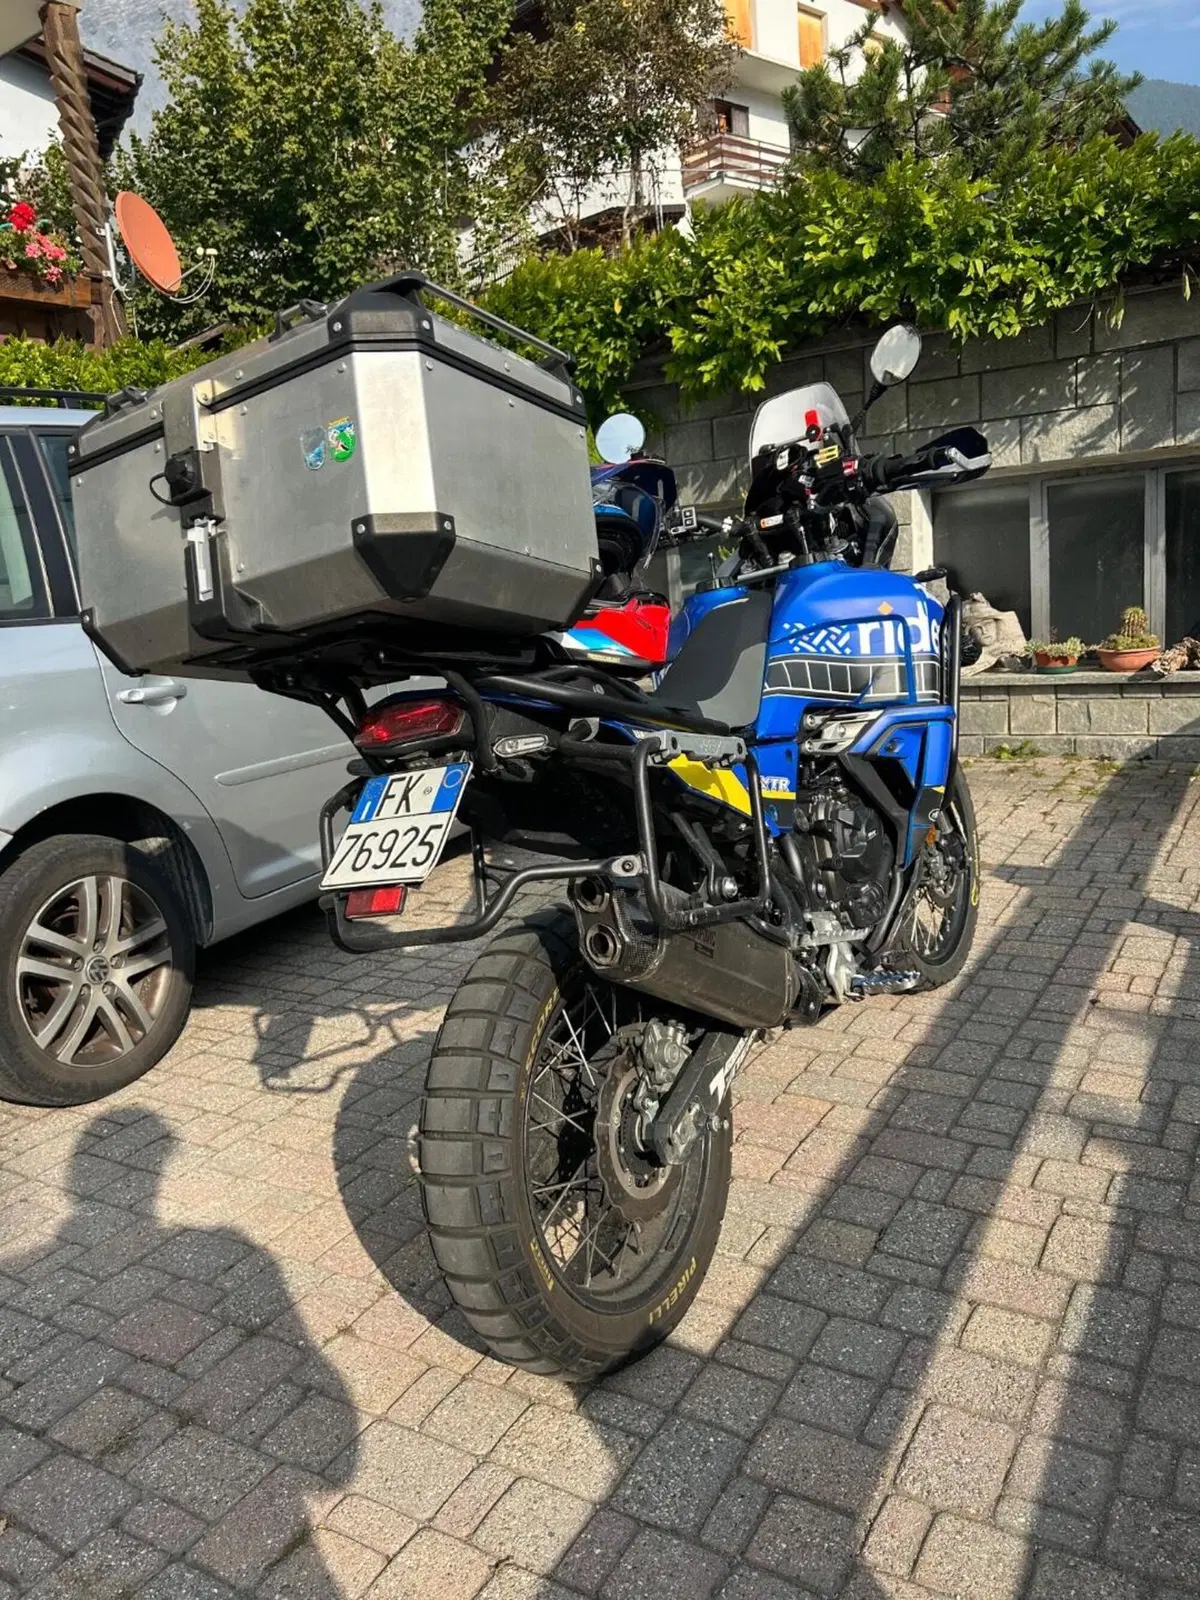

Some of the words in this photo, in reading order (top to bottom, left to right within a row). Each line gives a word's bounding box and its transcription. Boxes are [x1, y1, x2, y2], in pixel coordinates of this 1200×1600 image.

[376, 773, 425, 817] FK
[330, 824, 443, 875] 76925
[648, 1256, 697, 1326] PIRELLI
